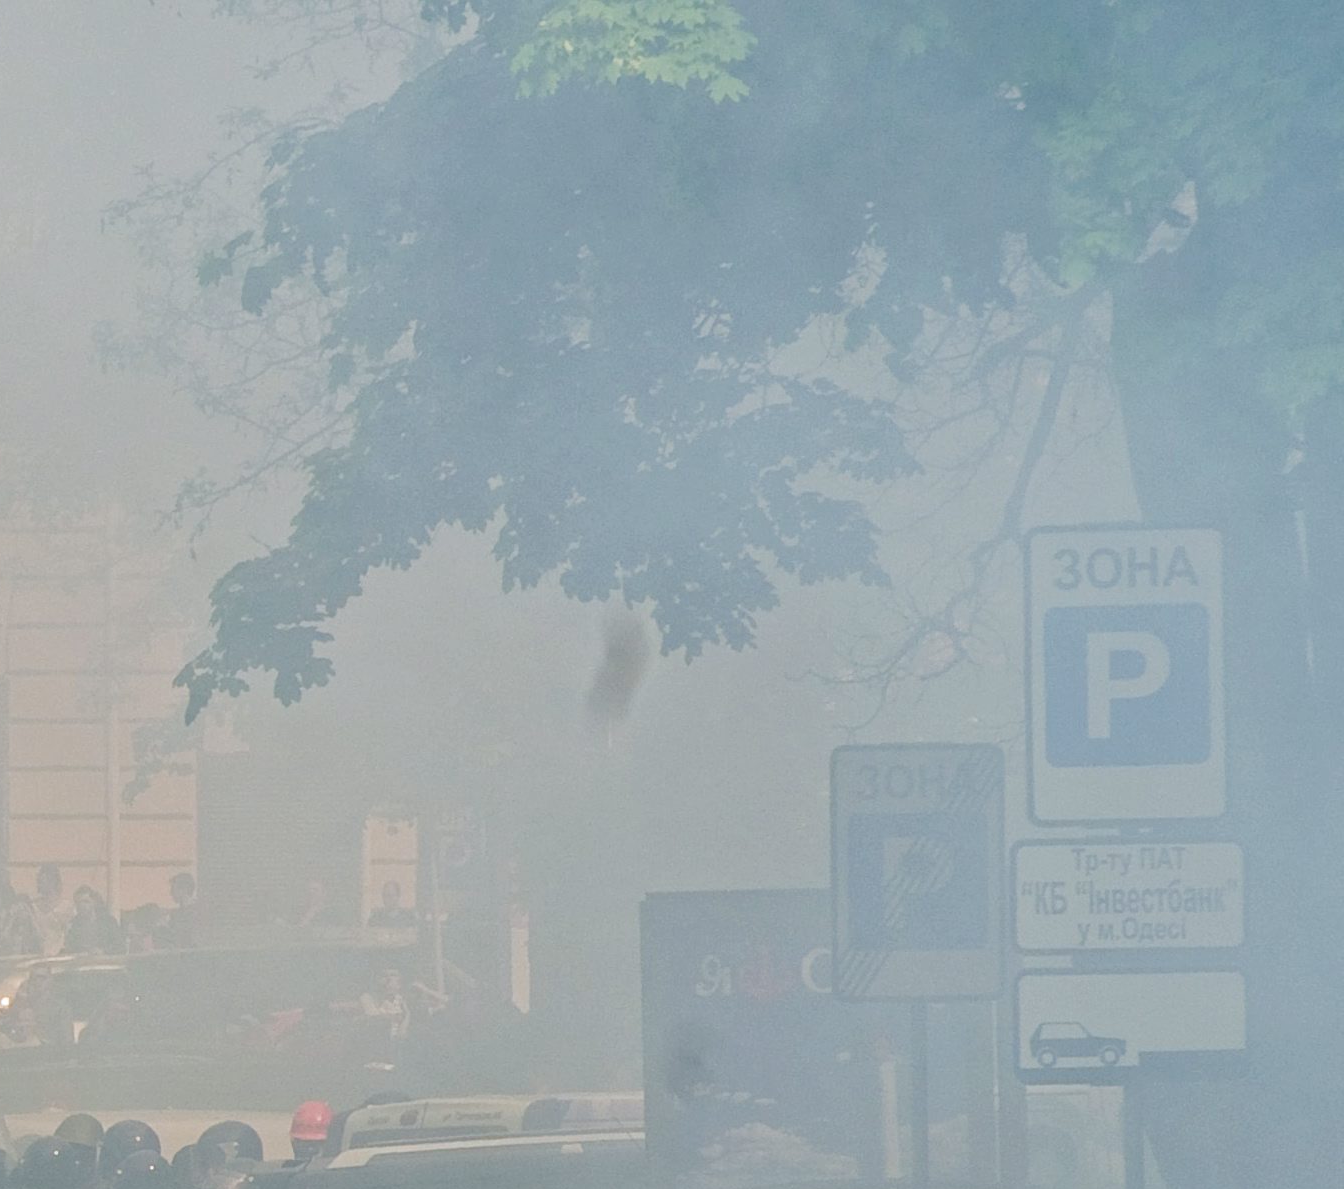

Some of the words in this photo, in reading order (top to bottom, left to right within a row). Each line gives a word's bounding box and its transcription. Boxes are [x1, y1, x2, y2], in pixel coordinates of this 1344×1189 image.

[1052, 546, 1201, 590] ЗОНА
[855, 764, 985, 803] ЗОНА
[1072, 847, 1131, 872] Тр-ту
[1139, 847, 1185, 870] ПАТ
[1077, 924, 1090, 944] у
